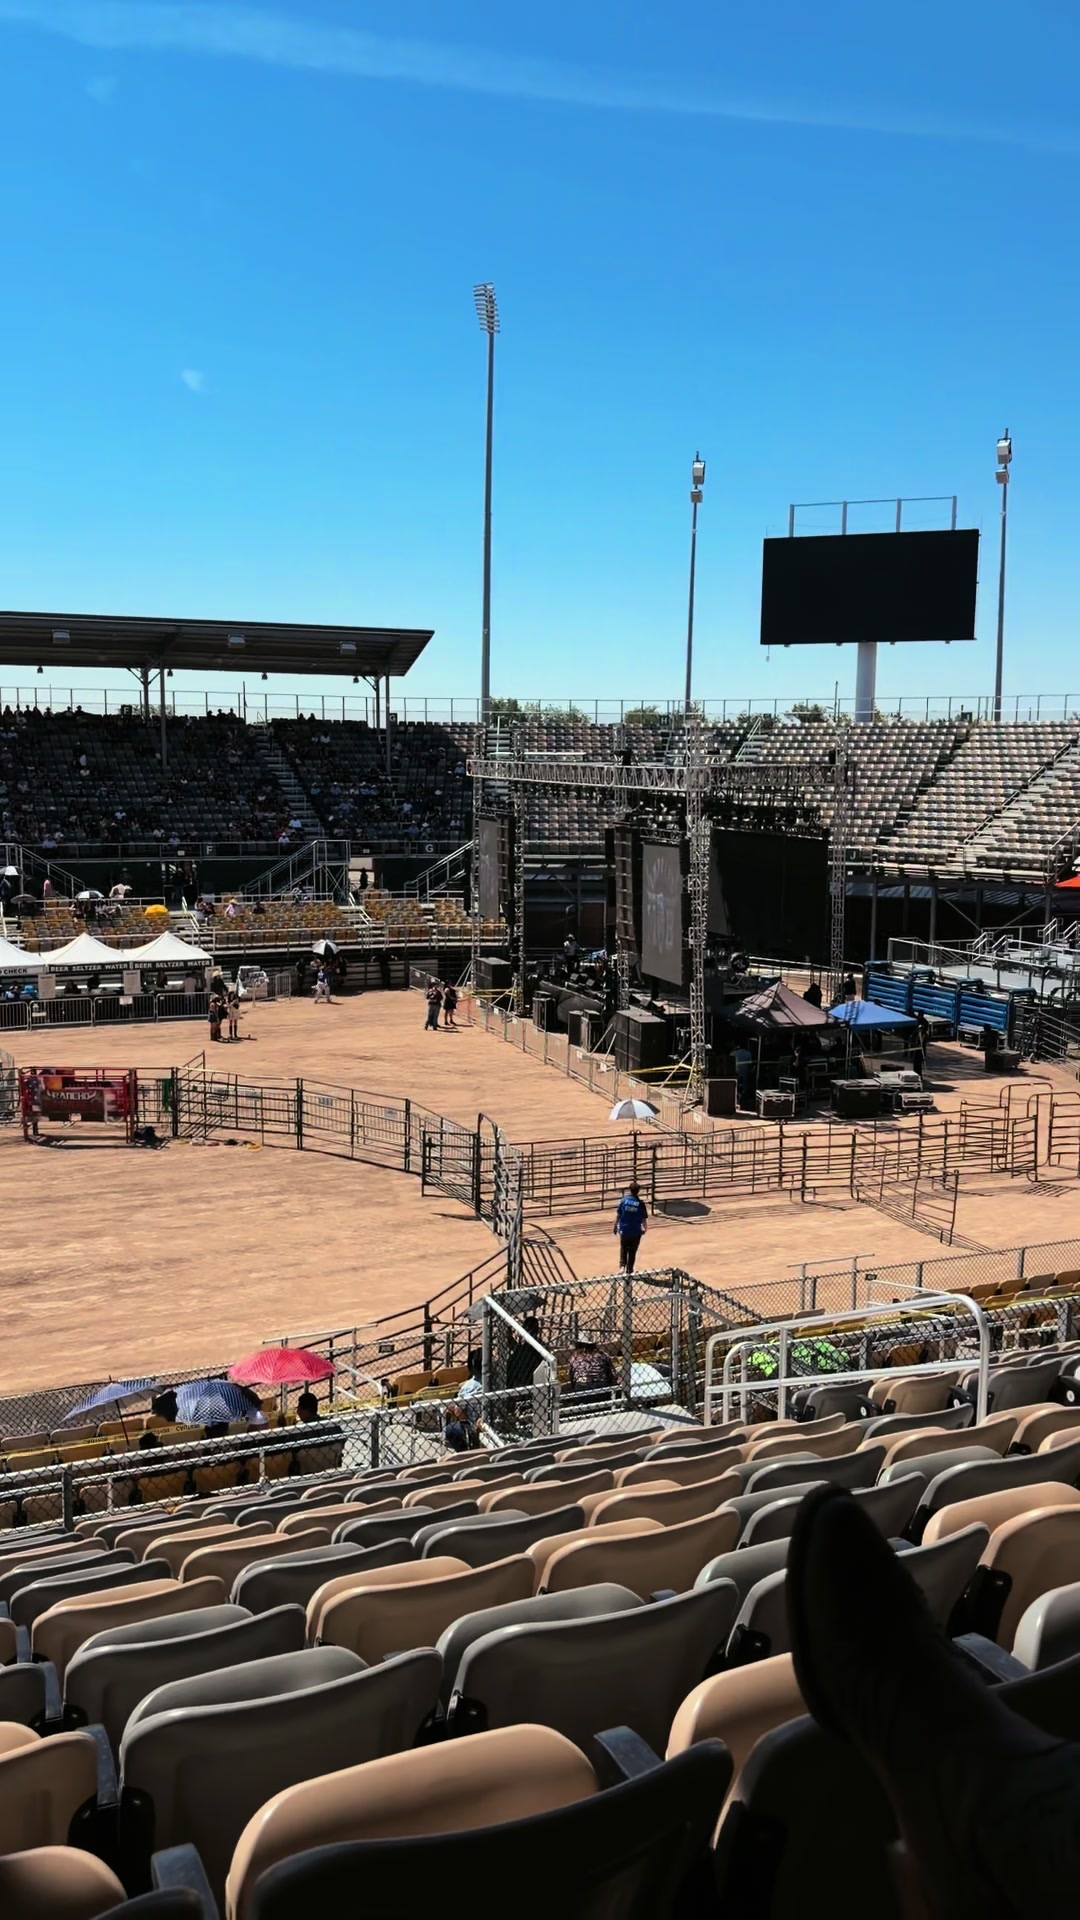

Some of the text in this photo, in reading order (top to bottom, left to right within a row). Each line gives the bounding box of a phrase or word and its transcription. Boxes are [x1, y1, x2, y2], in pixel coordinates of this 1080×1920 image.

[207, 845, 213, 855] F
[425, 843, 434, 853] G
[850, 850, 856, 860] J
[72, 964, 102, 972] SELTZER
[52, 1092, 90, 1100] RANCHO
